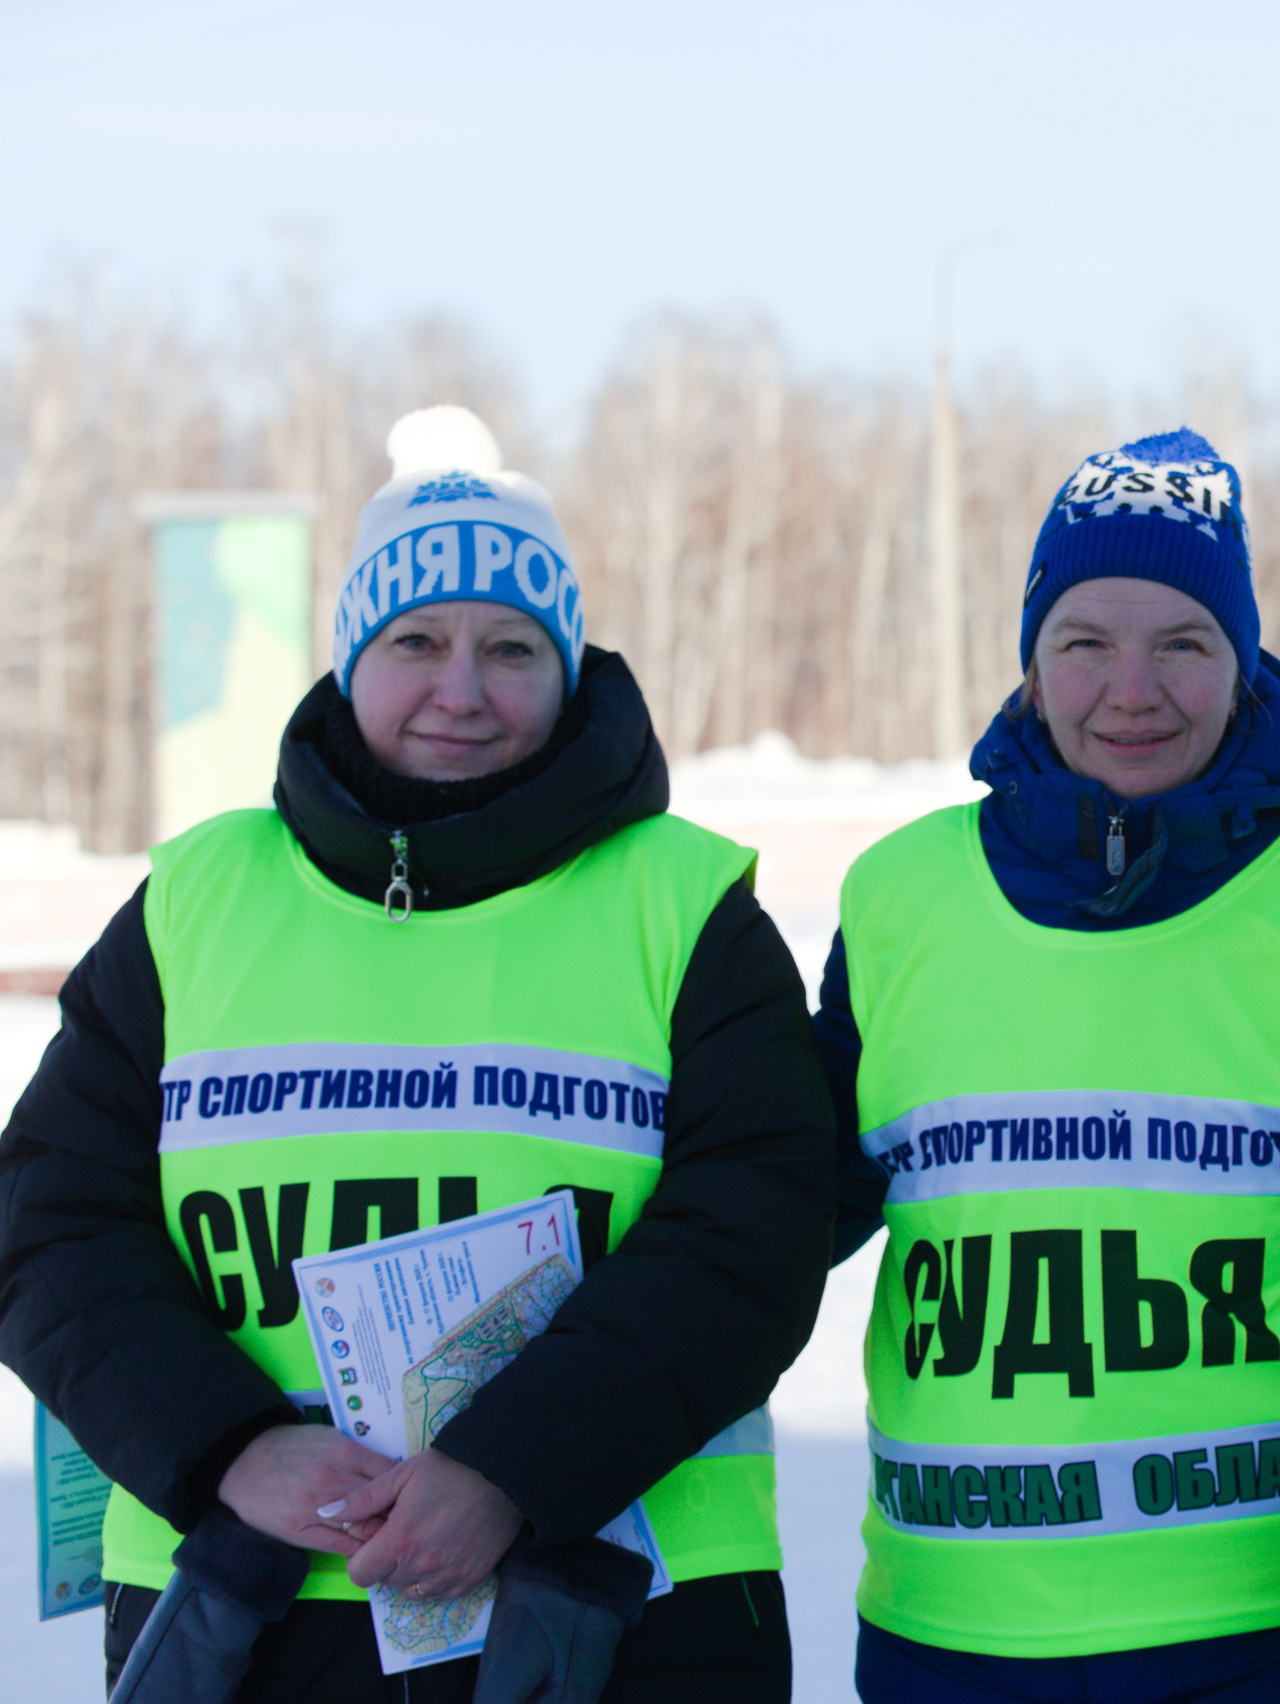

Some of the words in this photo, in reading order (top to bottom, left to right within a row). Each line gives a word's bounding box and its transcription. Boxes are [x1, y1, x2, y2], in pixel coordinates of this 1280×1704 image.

[199, 1062, 458, 1118] СПОРТИВНОЙ
[474, 1066, 666, 1131] ПОДГОТОВ
[919, 1109, 1132, 1171] СПОРТИВНОЙ
[517, 1214, 560, 1255] 7.1
[904, 1229, 1280, 1399] СУДЬЯ
